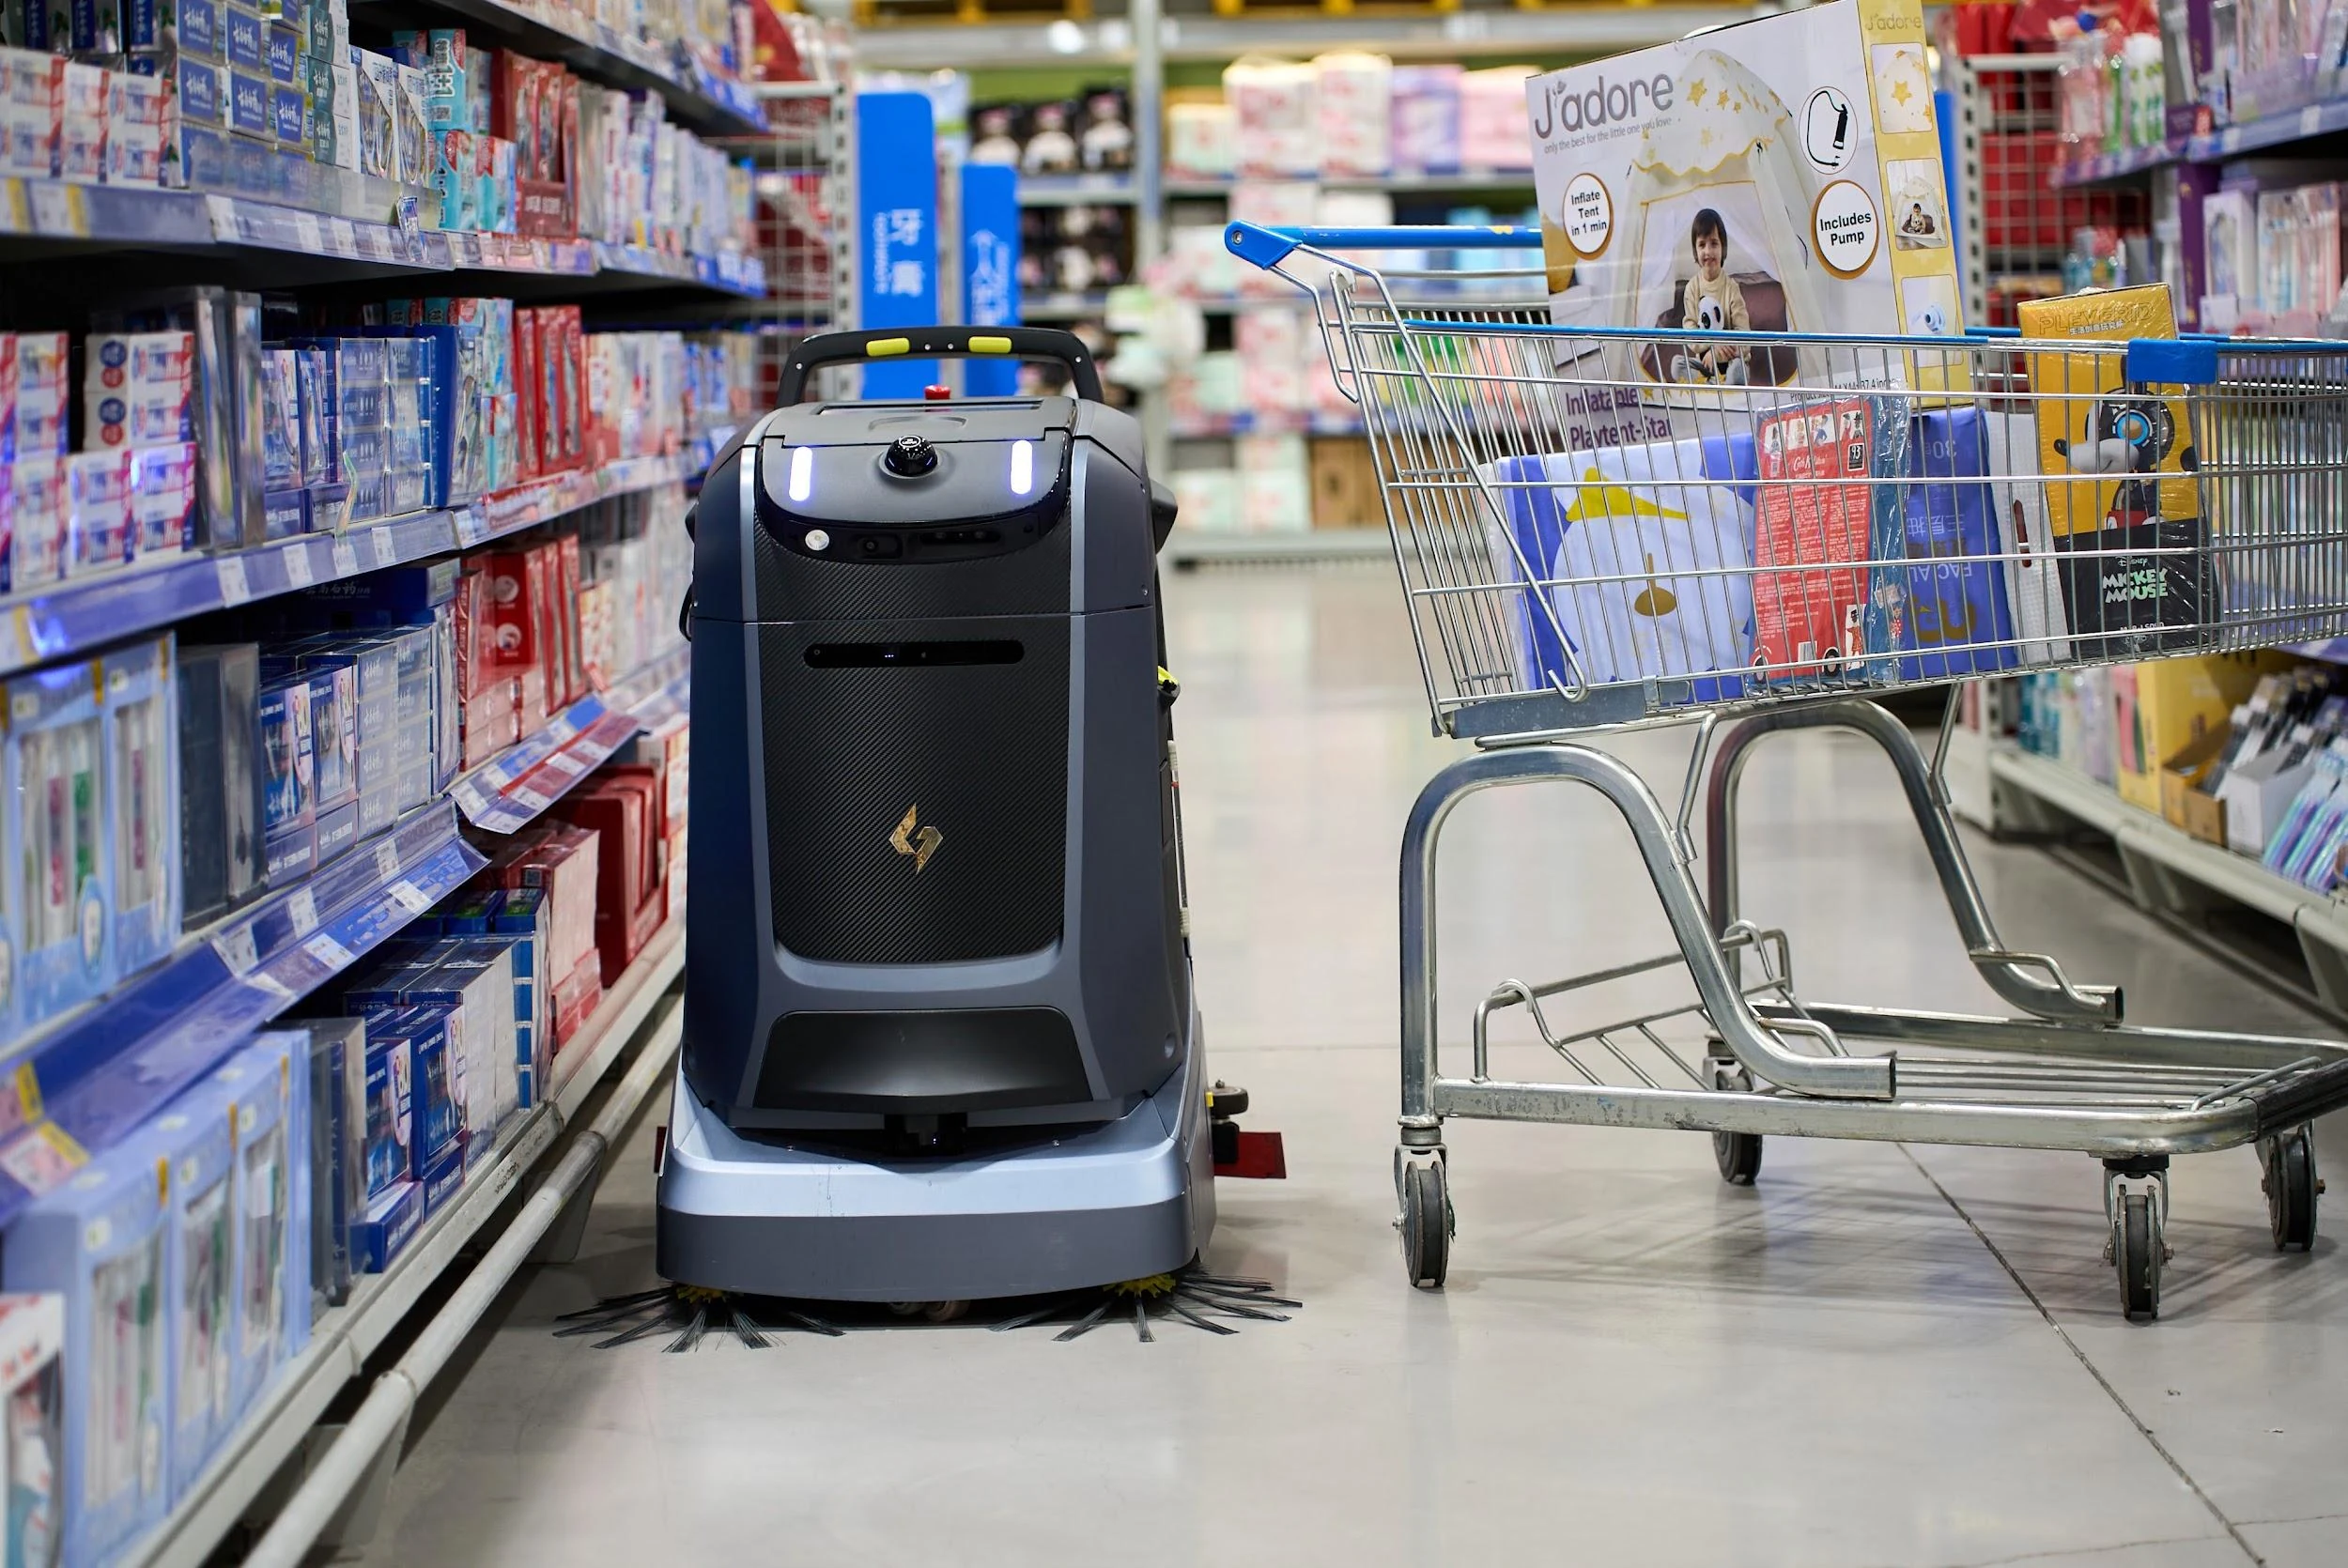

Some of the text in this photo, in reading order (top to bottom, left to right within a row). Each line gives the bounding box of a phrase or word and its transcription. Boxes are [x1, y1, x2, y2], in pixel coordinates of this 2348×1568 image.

[1865, 12, 1923, 31] J'adore
[1535, 73, 1674, 139] J'adore
[1544, 142, 1558, 155] only
[1559, 140, 1570, 151] the
[1571, 136, 1586, 148] best
[1586, 133, 1596, 145] for
[1598, 131, 1609, 142] the
[1610, 128, 1626, 139] little
[1627, 126, 1641, 135] one
[1571, 191, 1600, 206] Inflate
[1578, 206, 1599, 219] Tent
[1820, 212, 1872, 232] Includes
[1570, 219, 1607, 237] in 1 min
[1831, 231, 1864, 246] Pump
[1909, 561, 1972, 582] FACAL
[2102, 567, 2168, 590] MICKEY
[2105, 582, 2169, 604] MOUSE
